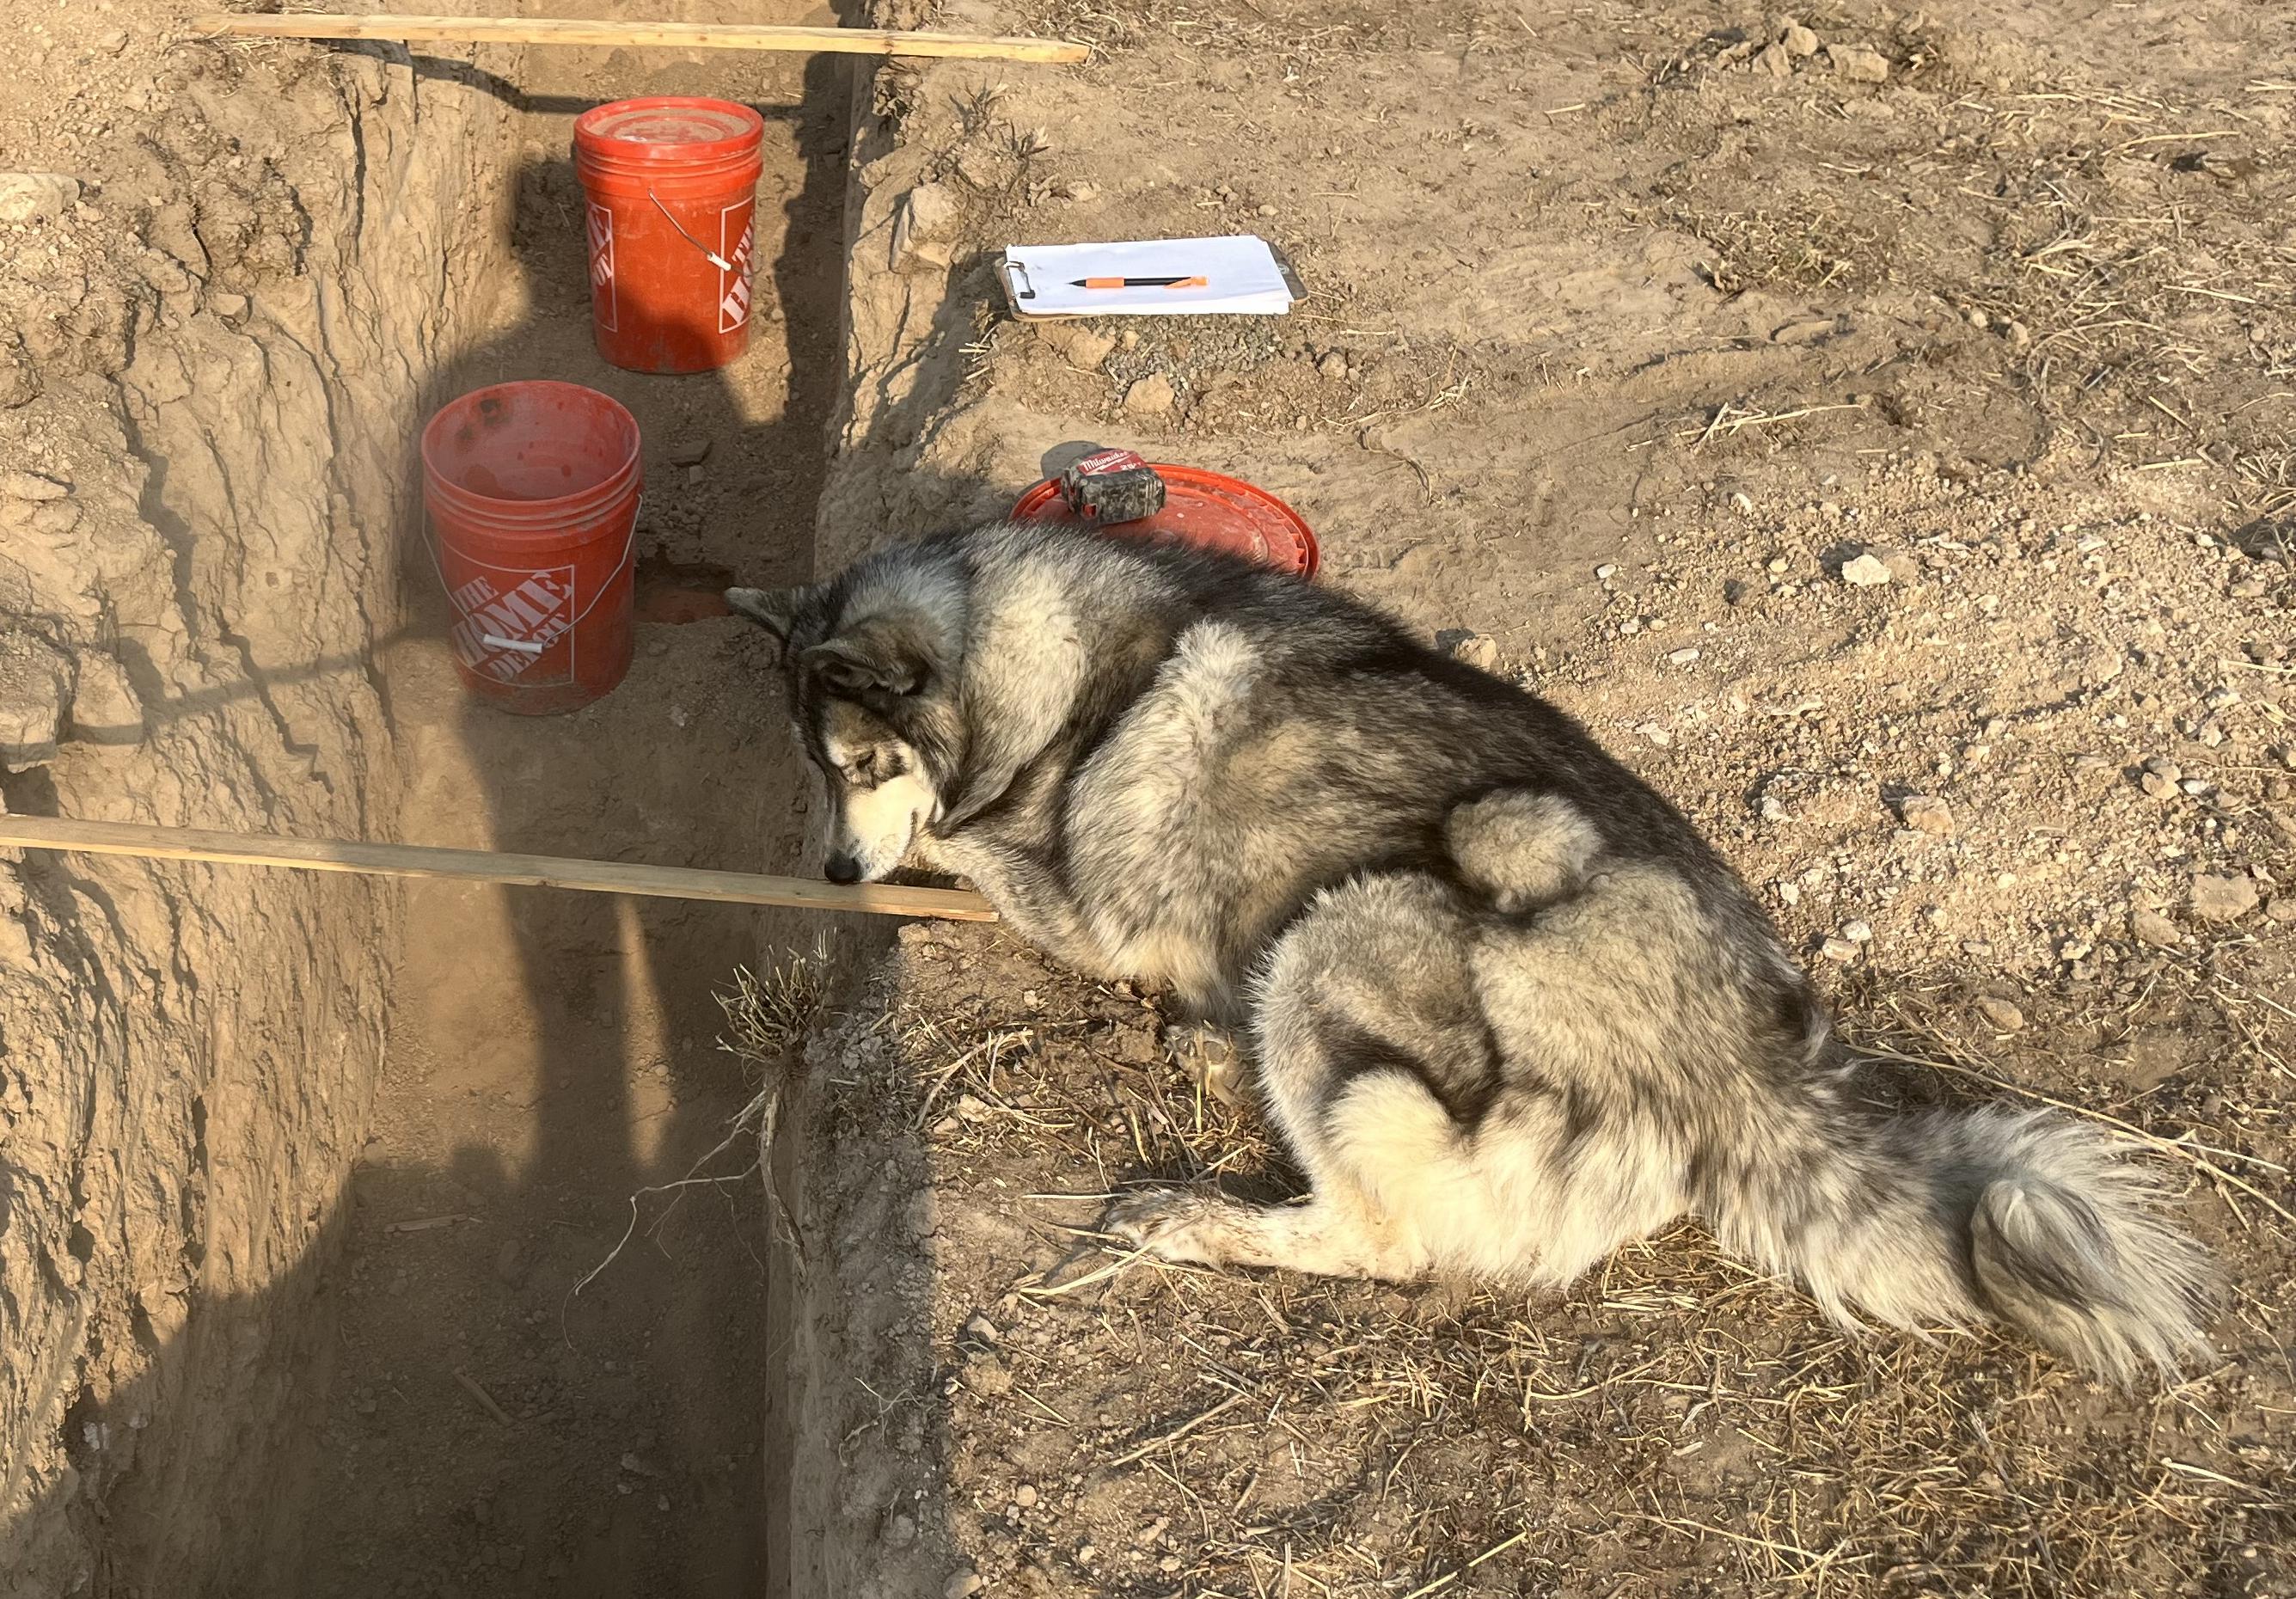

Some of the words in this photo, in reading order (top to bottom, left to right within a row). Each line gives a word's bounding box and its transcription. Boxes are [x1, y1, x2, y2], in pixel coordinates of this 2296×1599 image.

[1080, 450, 1128, 471] Milwaukee
[452, 575, 499, 613] THE
[452, 571, 572, 668] HOME
